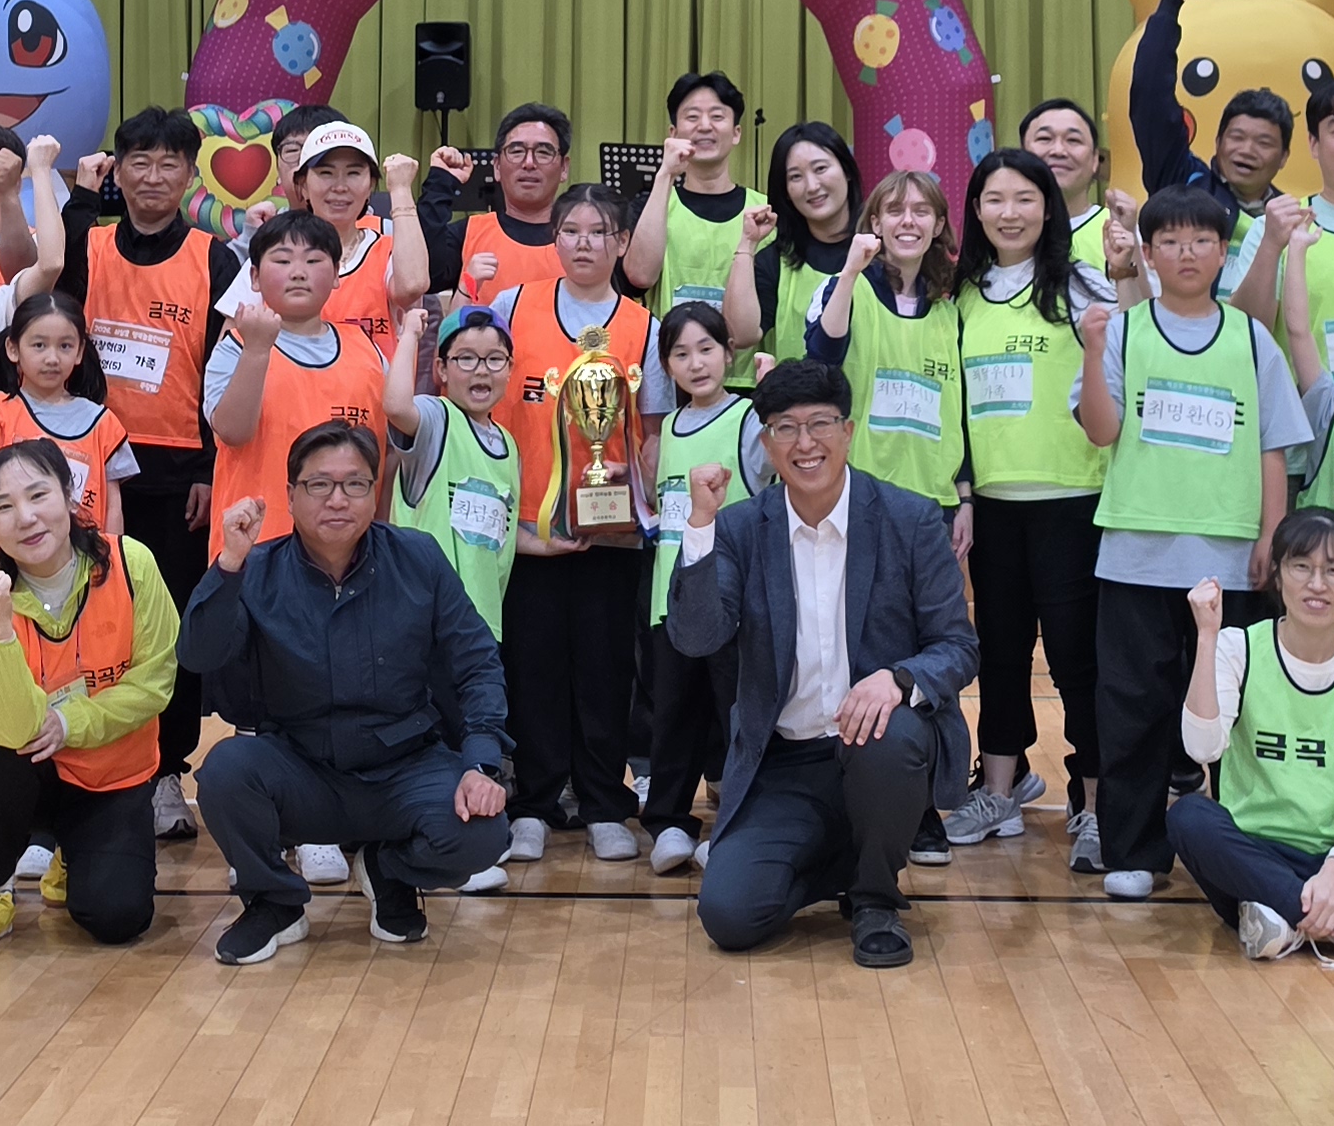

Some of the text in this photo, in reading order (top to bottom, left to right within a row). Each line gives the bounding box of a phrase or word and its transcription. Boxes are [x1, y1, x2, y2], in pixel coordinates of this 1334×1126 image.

[149, 301, 192, 325] 금곡초
[1005, 334, 1049, 354] 금곡초
[135, 354, 156, 371] 가족
